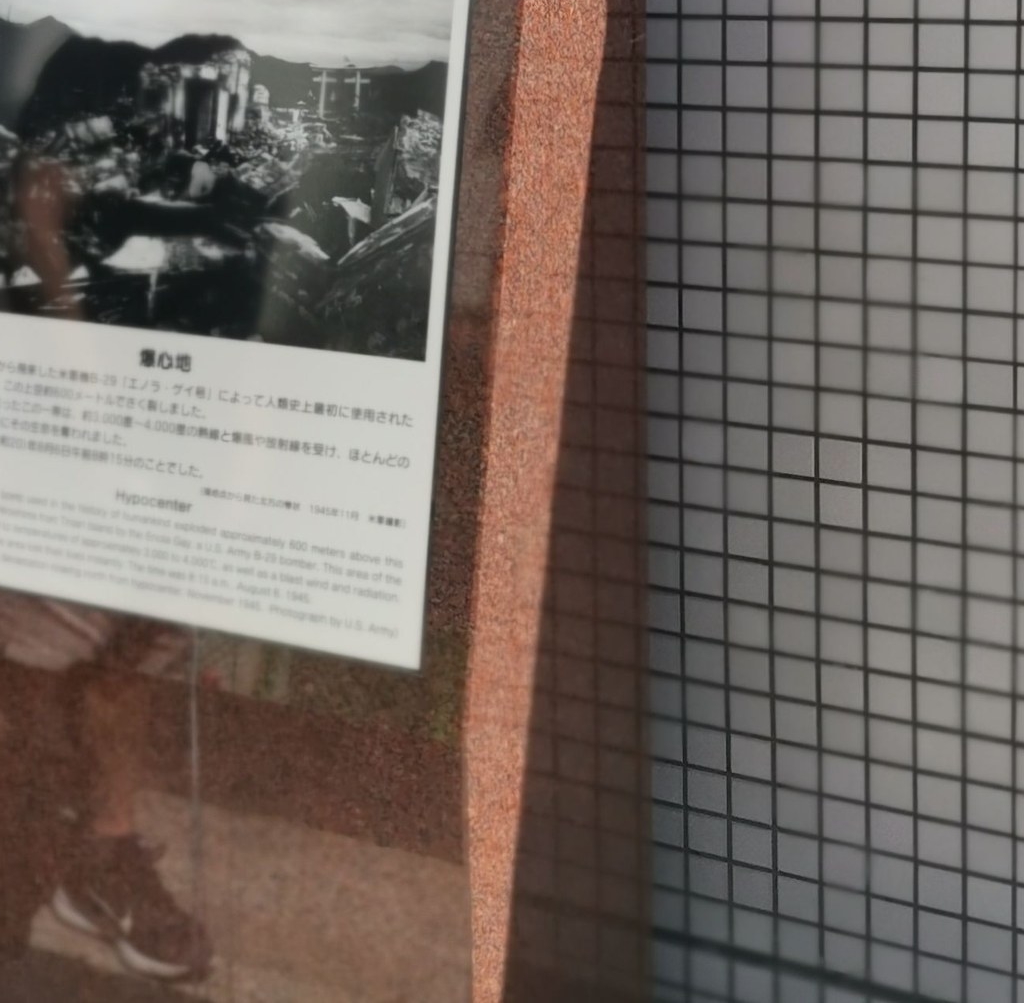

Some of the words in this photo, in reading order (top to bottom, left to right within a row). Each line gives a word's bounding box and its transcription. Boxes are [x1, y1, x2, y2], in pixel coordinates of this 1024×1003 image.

[114, 489, 192, 516] Hypocenter
[289, 537, 308, 551] 600
[311, 541, 345, 557] meters
[349, 547, 380, 563] above
[384, 553, 404, 567] this
[323, 561, 343, 574] This
[346, 565, 369, 579] area
[372, 570, 382, 581] of
[385, 572, 402, 585] the
[331, 580, 350, 593] and
